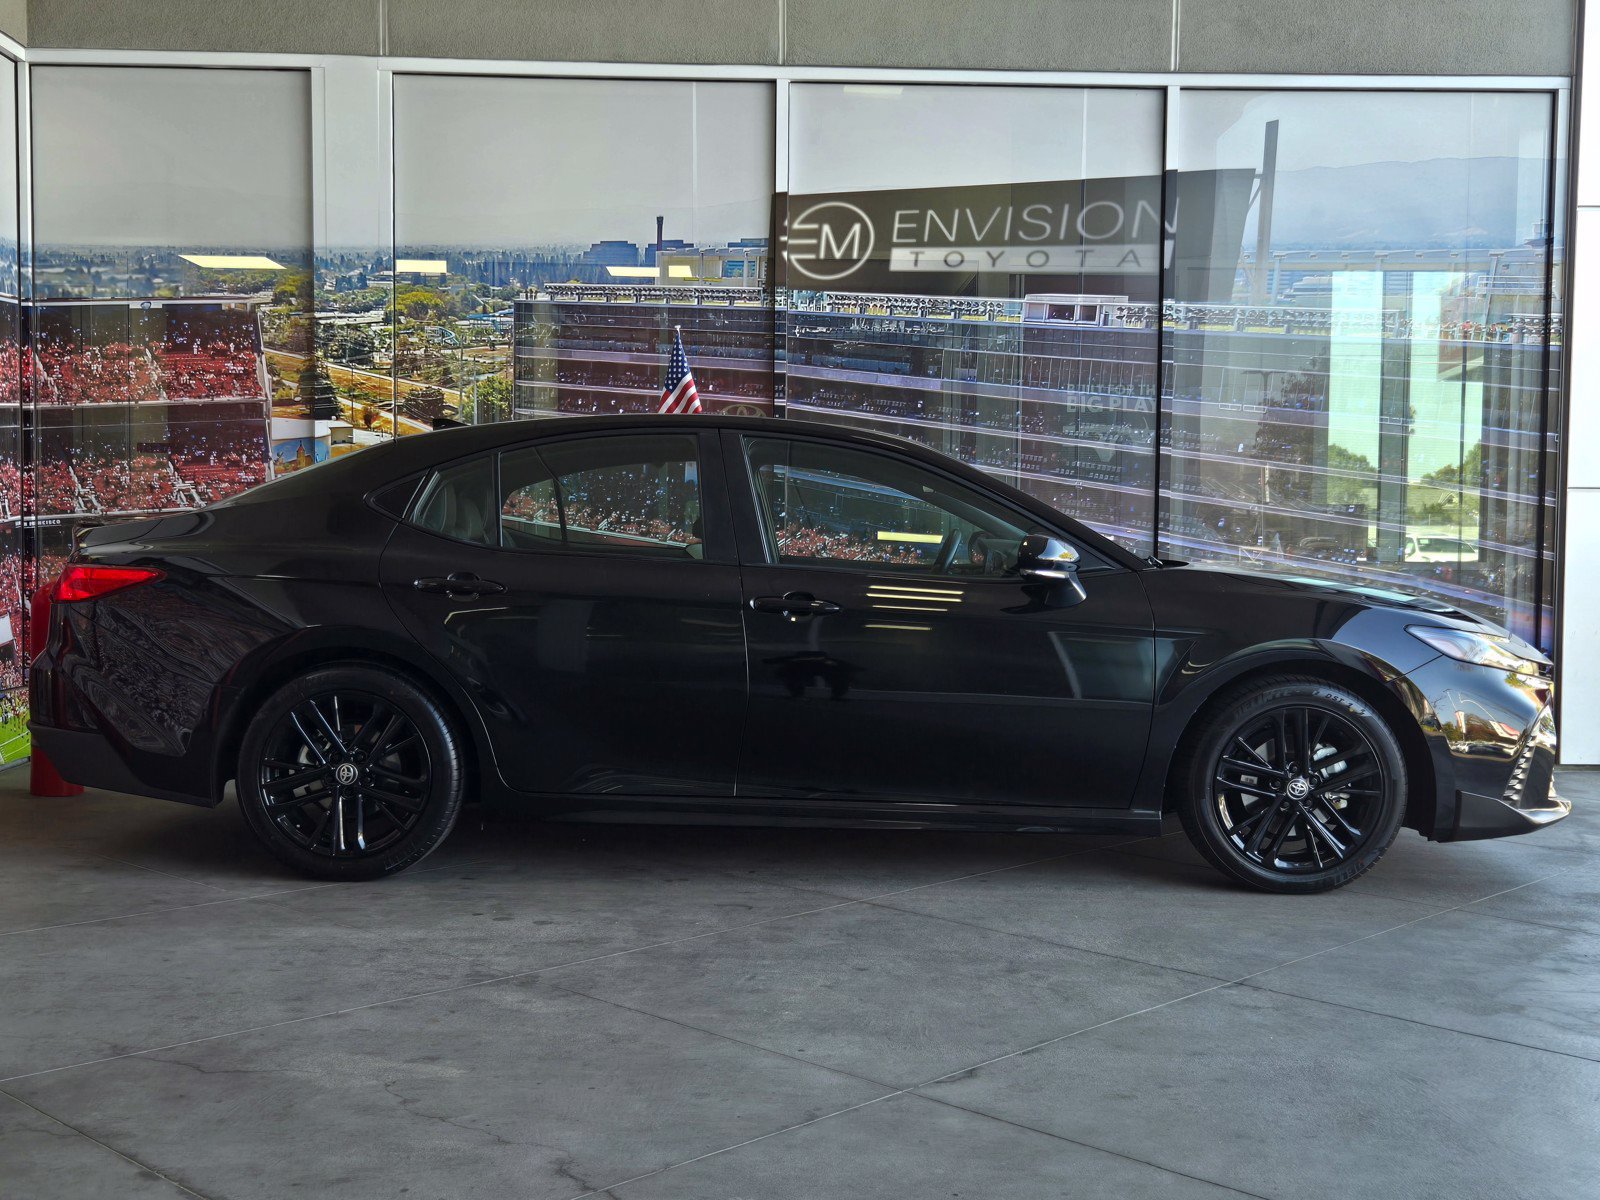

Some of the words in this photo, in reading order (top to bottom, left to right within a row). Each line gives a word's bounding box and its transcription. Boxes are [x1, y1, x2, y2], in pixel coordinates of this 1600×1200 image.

[892, 197, 1179, 243] ENVISION
[909, 249, 1142, 268] TOYOTA
[1067, 396, 1104, 412] BIG
